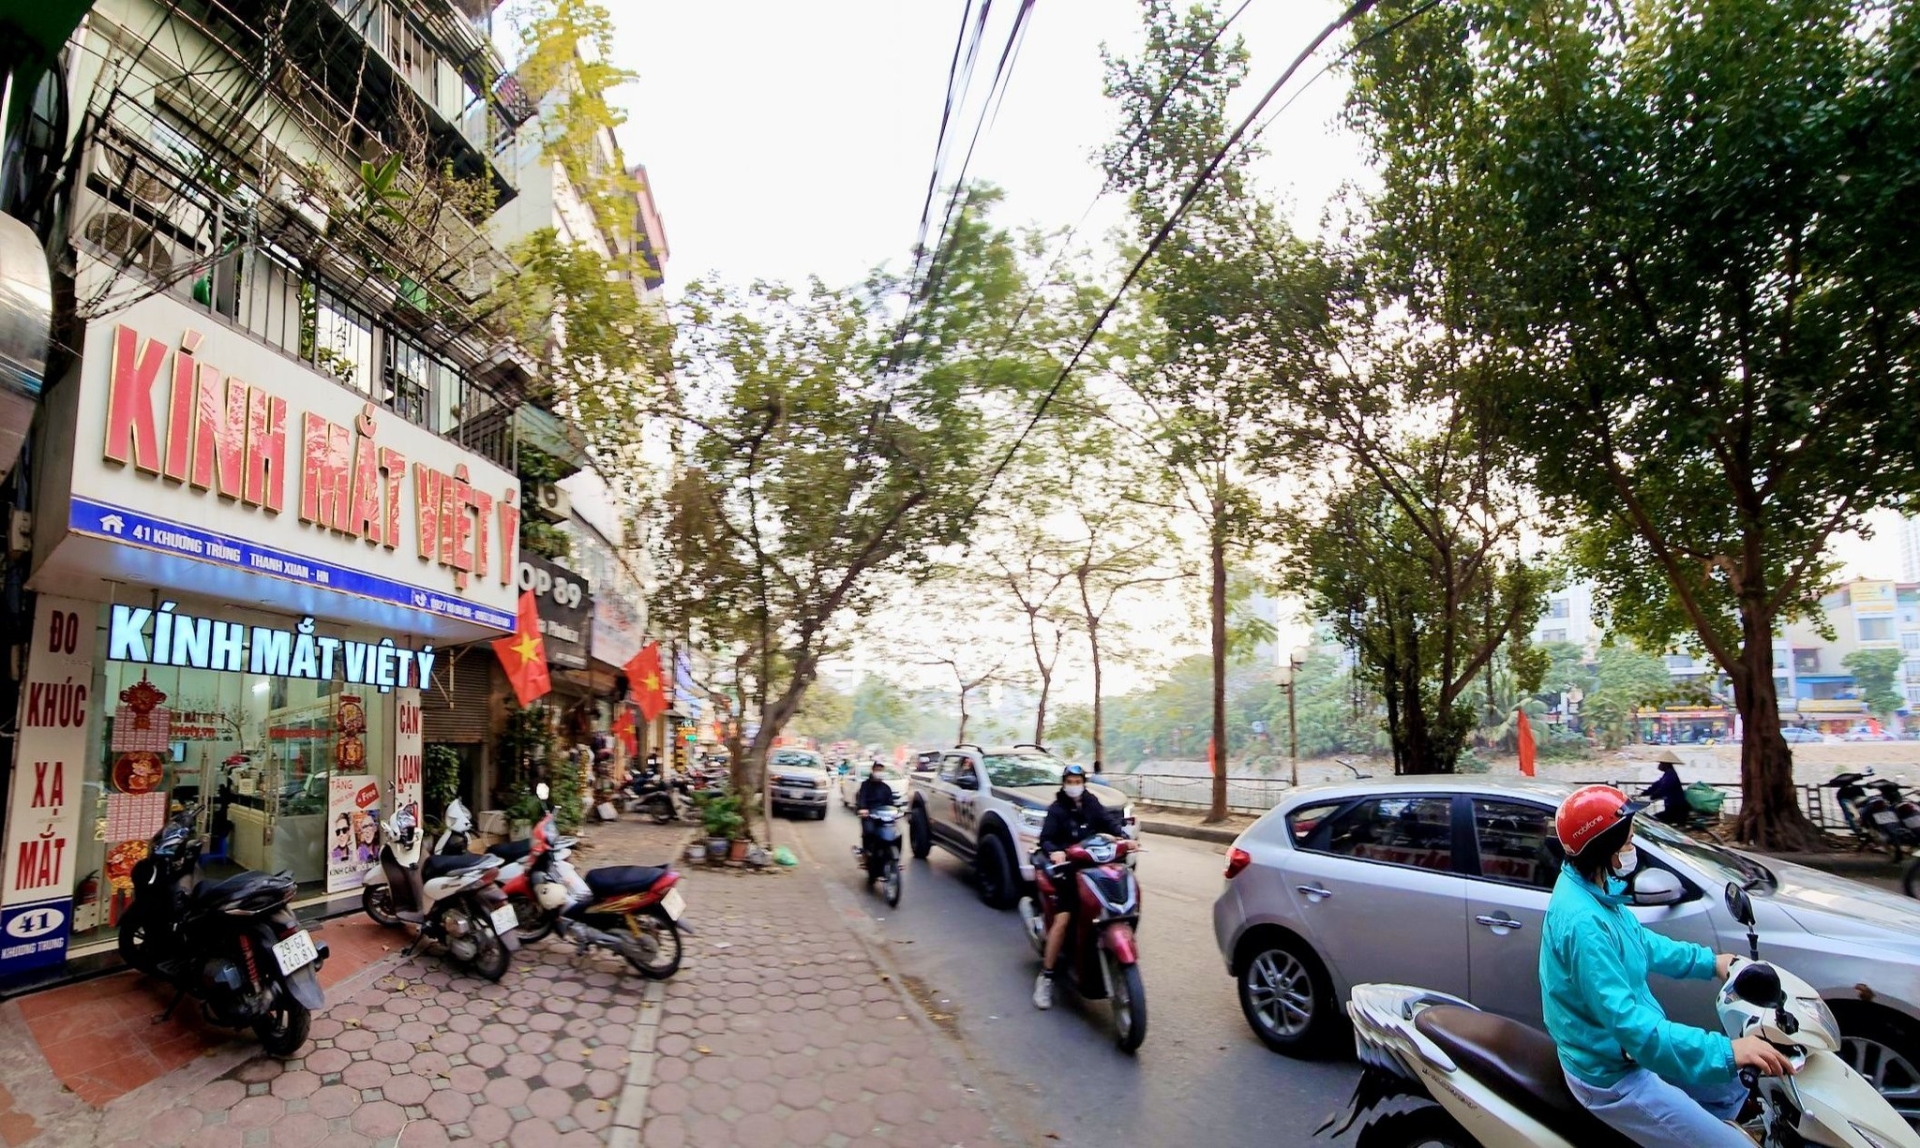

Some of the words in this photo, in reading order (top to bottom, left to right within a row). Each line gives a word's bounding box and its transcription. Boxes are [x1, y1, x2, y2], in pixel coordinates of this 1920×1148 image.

[103, 324, 287, 514] KÍNH
[299, 402, 406, 549] MẮT
[413, 463, 492, 590] VIỆT
[498, 487, 520, 585] Ý
[132, 524, 151, 541] 41
[249, 552, 283, 573] THANH
[553, 576, 582, 609] 89
[48, 610, 79, 655] ĐO
[109, 601, 244, 672] KÍNH
[250, 616, 340, 680] MẮT
[344, 637, 413, 693] VIỆT
[416, 645, 436, 691] Ý
[27, 676, 88, 728] KHÚC
[399, 700, 419, 740] CẬN
[31, 761, 64, 816] XẠ
[1572, 814, 1604, 839] mobifone
[15, 823, 66, 891] MẮT
[18, 911, 50, 934] 41
